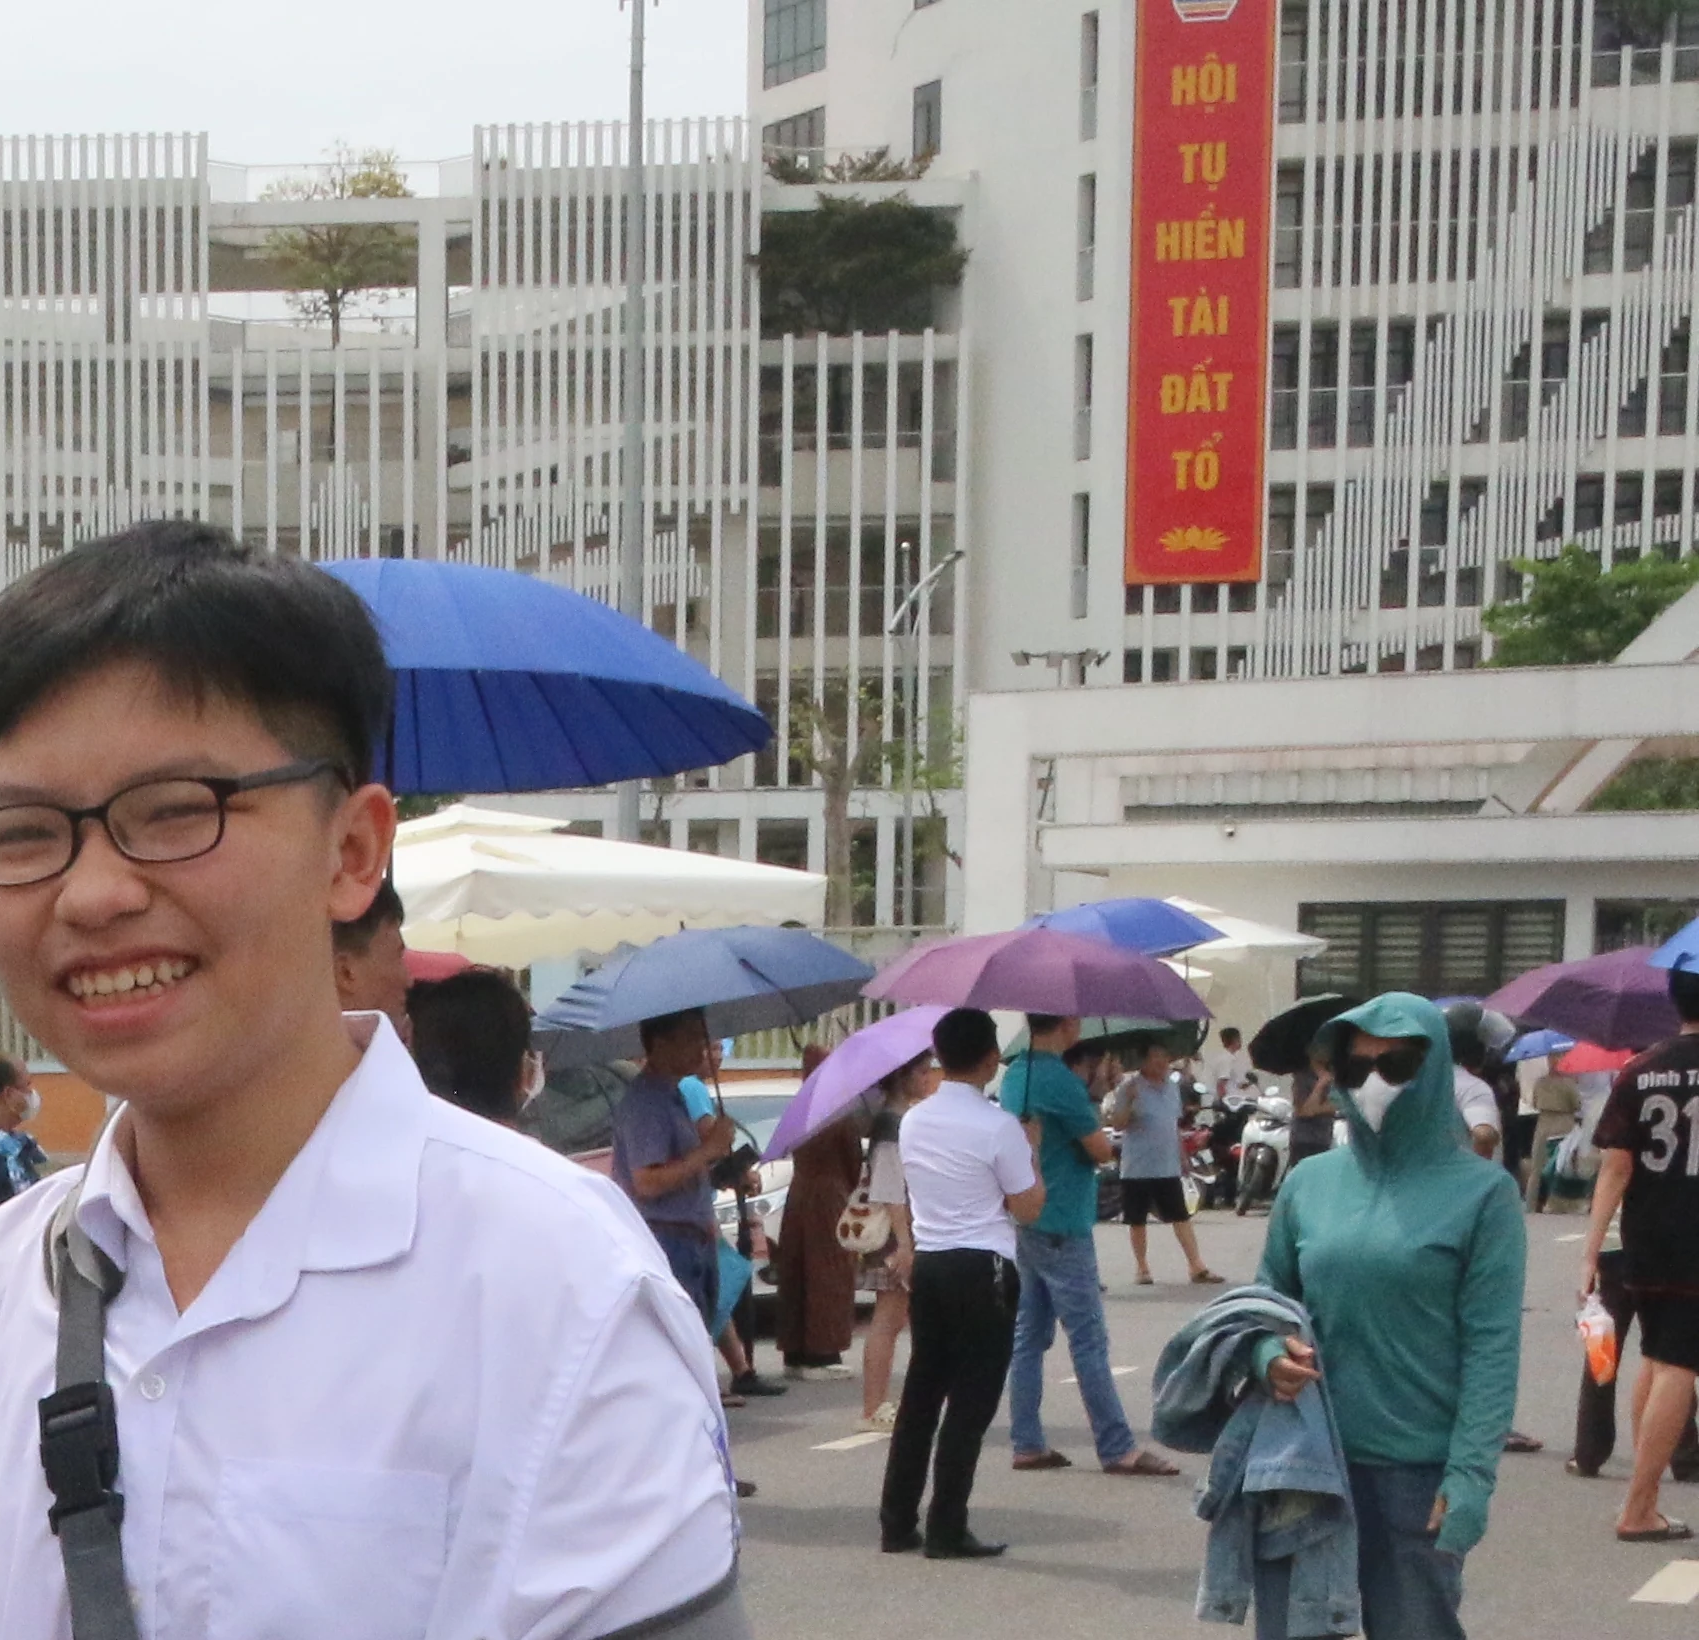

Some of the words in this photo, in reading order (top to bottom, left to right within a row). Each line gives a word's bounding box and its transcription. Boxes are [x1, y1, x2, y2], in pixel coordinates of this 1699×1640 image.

[1171, 52, 1237, 114] HỘI
[1178, 141, 1228, 191] TỤ
[1168, 287, 1230, 337] TÀI
[1159, 356, 1234, 415] ĐẤT
[1686, 1069, 1699, 1087] T
[1639, 1094, 1699, 1176] 31
